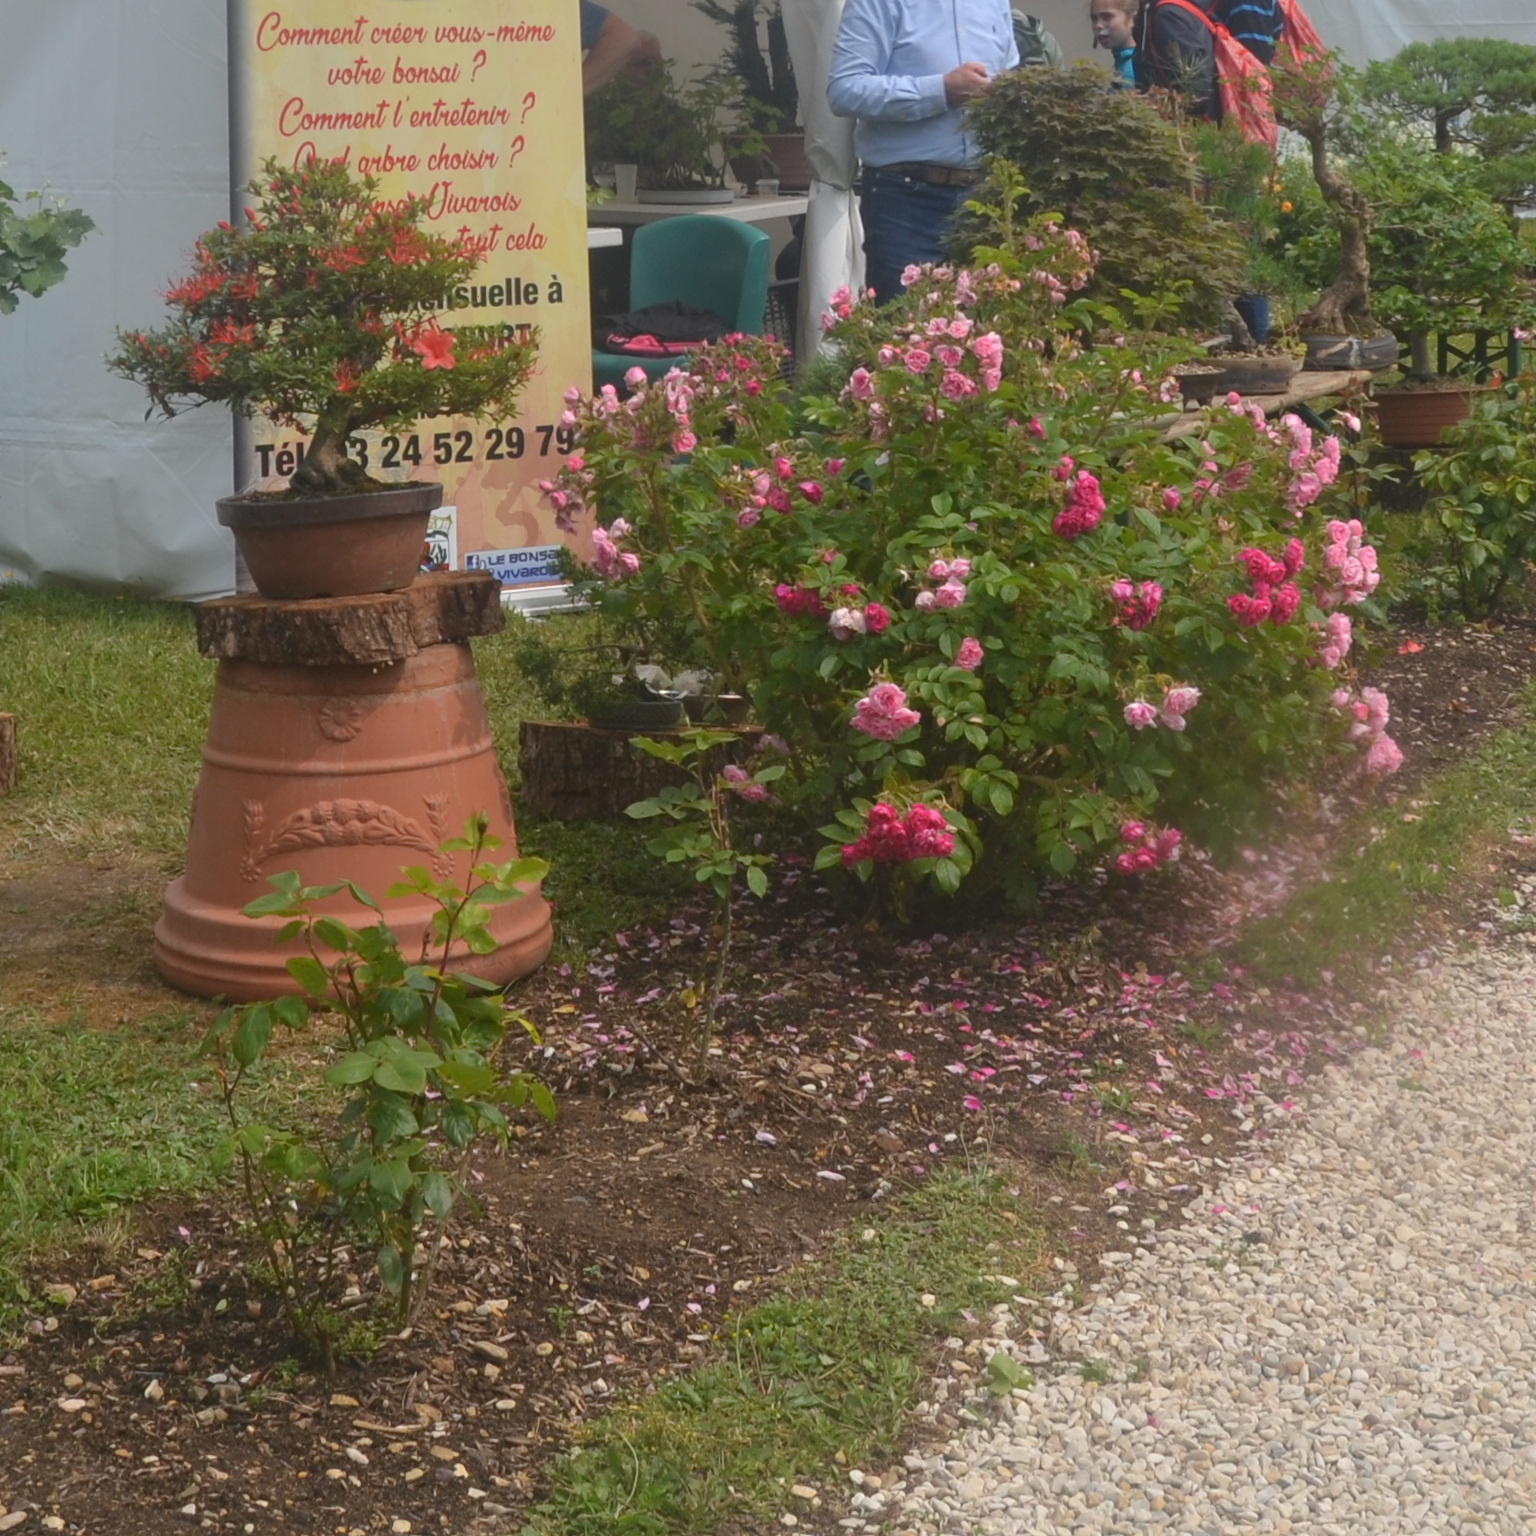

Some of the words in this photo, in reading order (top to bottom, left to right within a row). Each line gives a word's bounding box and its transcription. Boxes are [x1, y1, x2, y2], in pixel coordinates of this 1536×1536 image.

[256, 11, 368, 51] Comment
[370, 22, 427, 44] créer
[434, 21, 556, 44] vous-même
[327, 56, 385, 85] votre
[392, 56, 460, 85] bonsai
[470, 49, 487, 83] ?
[279, 96, 390, 137] Comment
[520, 91, 536, 125] ?
[357, 144, 420, 174] arbre
[427, 142, 499, 171] choisir
[508, 135, 525, 169] ?
[425, 181, 522, 221] Vivarois
[457, 223, 504, 253] tout
[505, 222, 549, 252] cela
[547, 274, 563, 304] à
[381, 435, 421, 468] 24
[433, 430, 473, 465] 52
[485, 427, 524, 461] 29
[535, 425, 574, 457] 79
[487, 554, 505, 566] LE
[509, 549, 558, 564] BONSA
